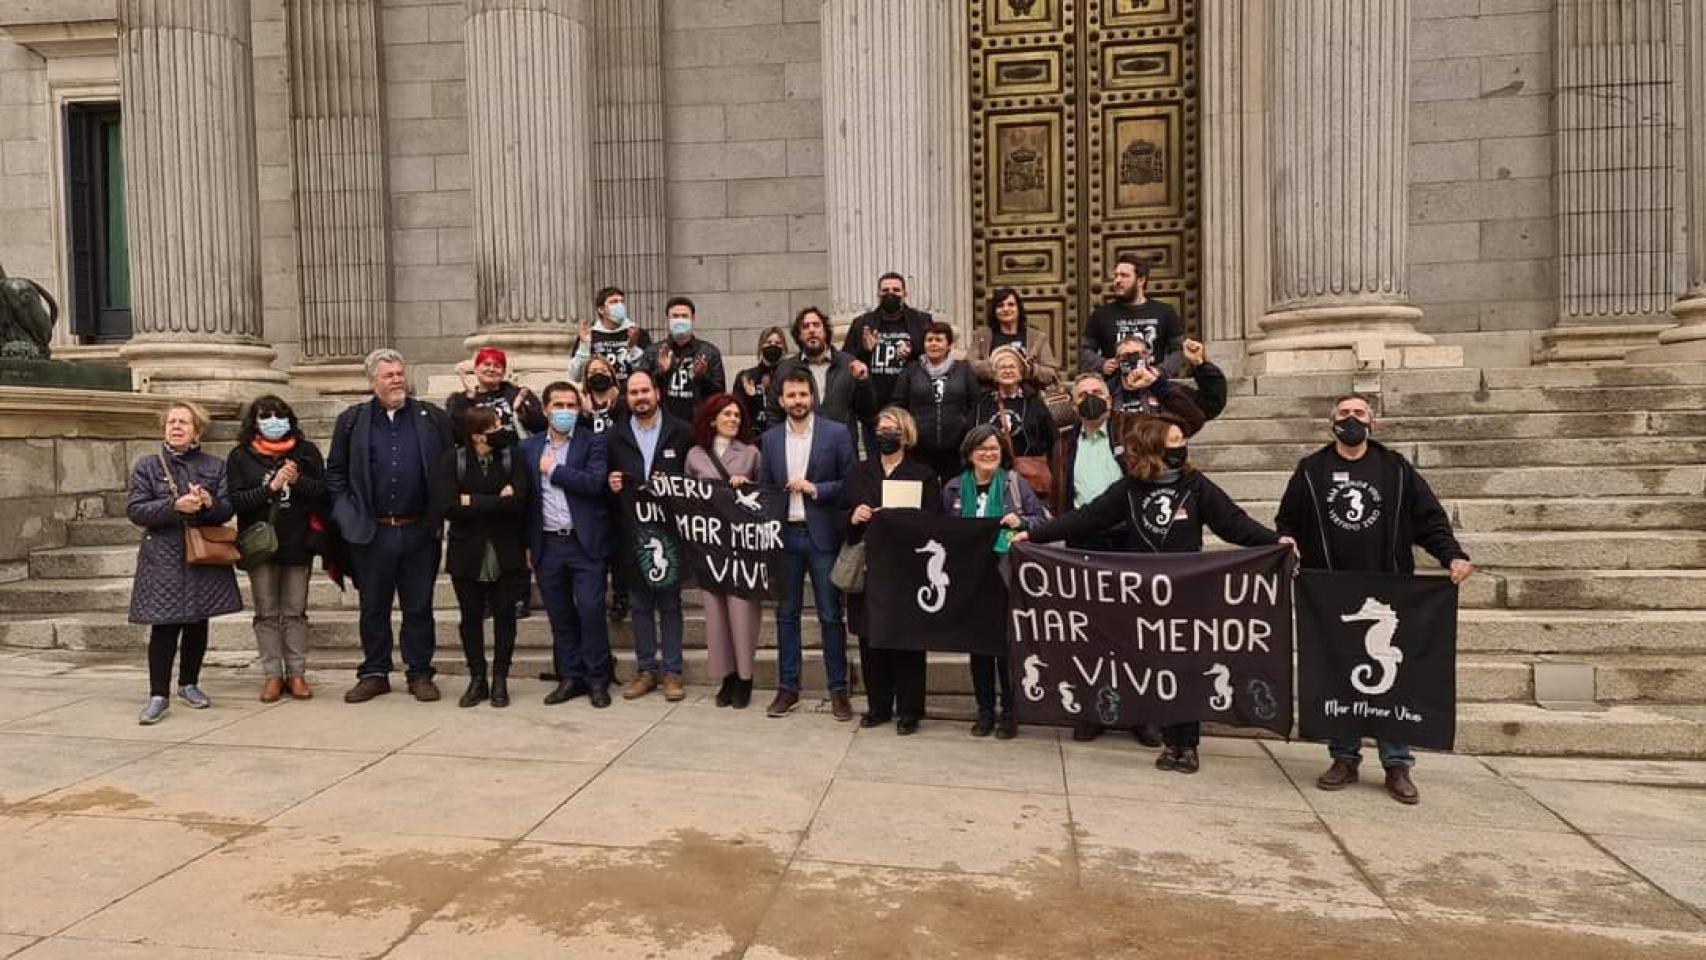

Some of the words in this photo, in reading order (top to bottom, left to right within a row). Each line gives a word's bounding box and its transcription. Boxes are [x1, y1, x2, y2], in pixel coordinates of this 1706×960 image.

[675, 514, 722, 546] MAR
[1019, 561, 1173, 607] QUIERO
[1224, 573, 1279, 606] UN
[1012, 608, 1089, 642] MAR
[1136, 616, 1272, 652] MENOR
